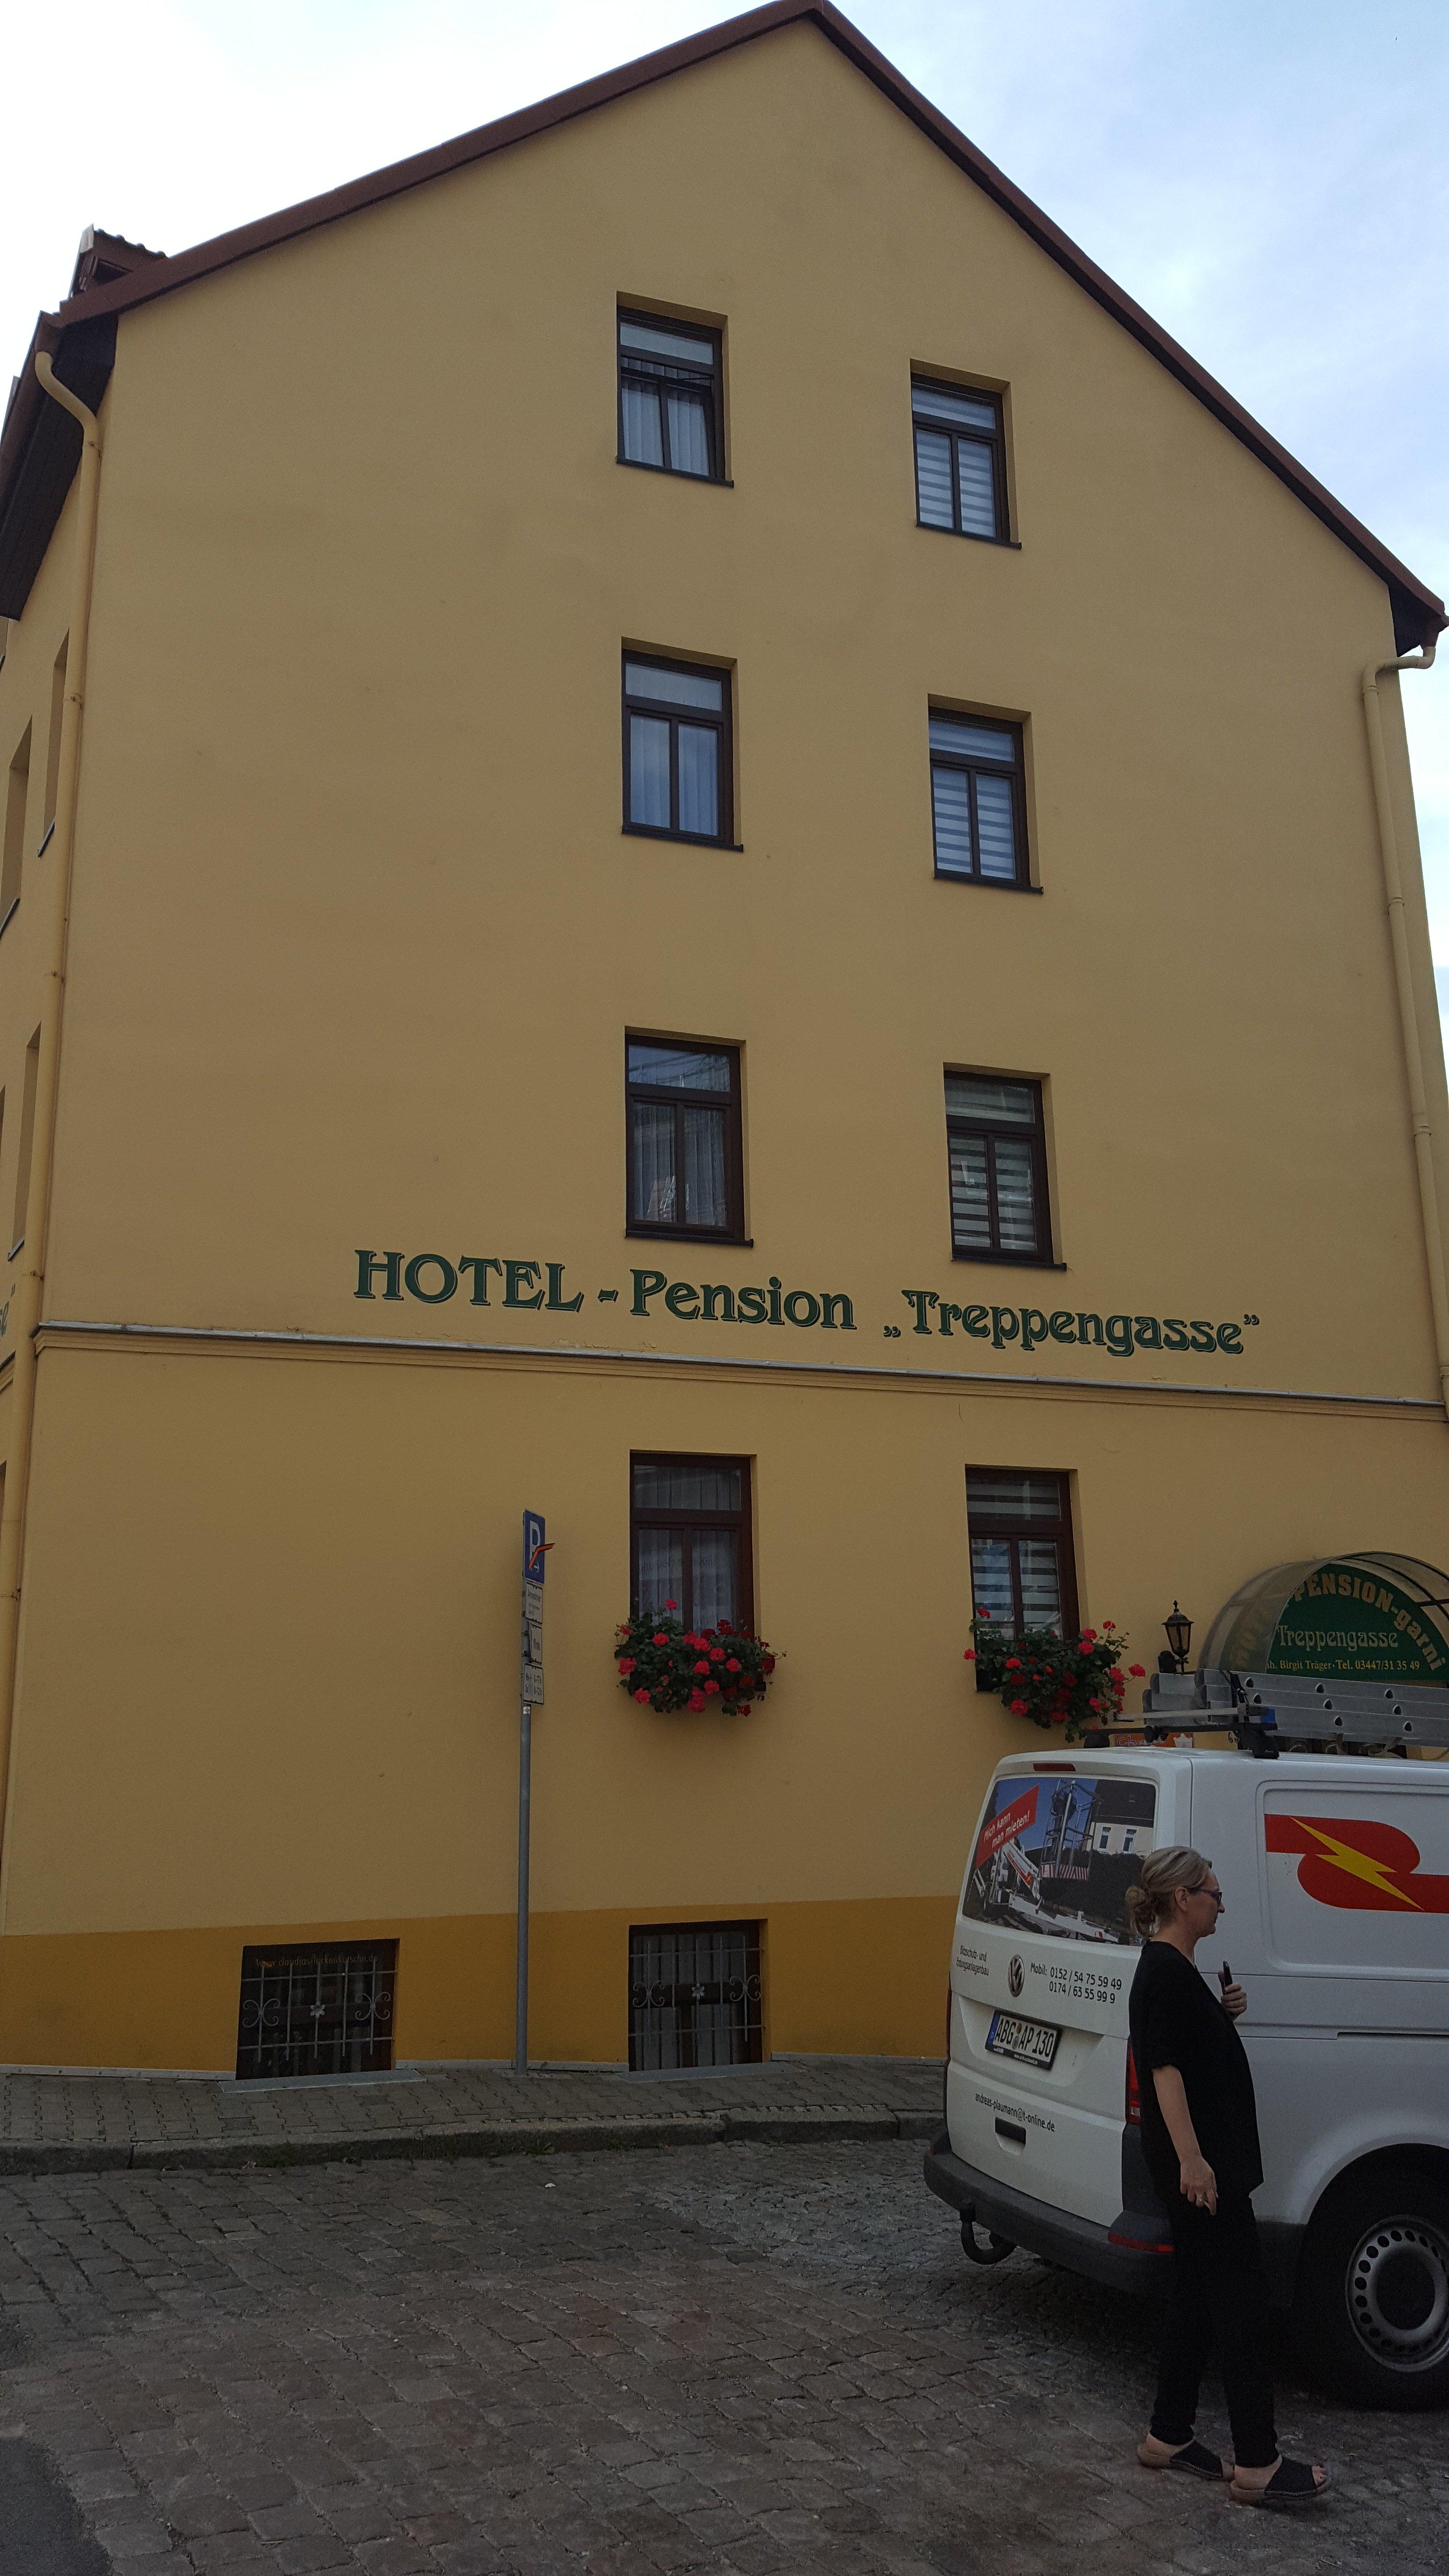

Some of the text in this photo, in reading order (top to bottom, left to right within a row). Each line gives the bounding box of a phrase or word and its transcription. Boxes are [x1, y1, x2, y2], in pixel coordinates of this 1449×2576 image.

[354, 1249, 584, 1313] HOTEL
[629, 1268, 857, 1330] Pension
[1276, 1625, 1399, 1651] Treppengasse
[1280, 1660, 1303, 1671] Birgit
[1305, 1659, 1332, 1671] Träger
[1335, 1659, 1353, 1670] Tel.
[1355, 1660, 1394, 1670] 03447/31
[1397, 1660, 1407, 1670] 35
[1409, 1660, 1420, 1670] 49
[983, 1812, 1011, 1843] Mich kann
[992, 1809, 1030, 1849] man mieten!
[1030, 1962, 1047, 1976] Mobil:
[1050, 1966, 1067, 1980] 0152
[1074, 1971, 1084, 1984] 54
[1086, 1973, 1095, 1985] 75
[1097, 1975, 1109, 1987] 59
[1111, 1978, 1122, 1990] 49
[1049, 1981, 1066, 1994] 0174
[1073, 1986, 1082, 1997] 63
[1084, 1988, 1095, 2000] 55
[1097, 1990, 1108, 2002] 99
[1110, 1993, 1116, 2004] 9
[994, 2018, 1016, 2045] ABG
[1018, 2025, 1034, 2051] AP
[1031, 2029, 1054, 2058] 130
[975, 2093, 1055, 2132] andreas-plaumann@t-online.de
